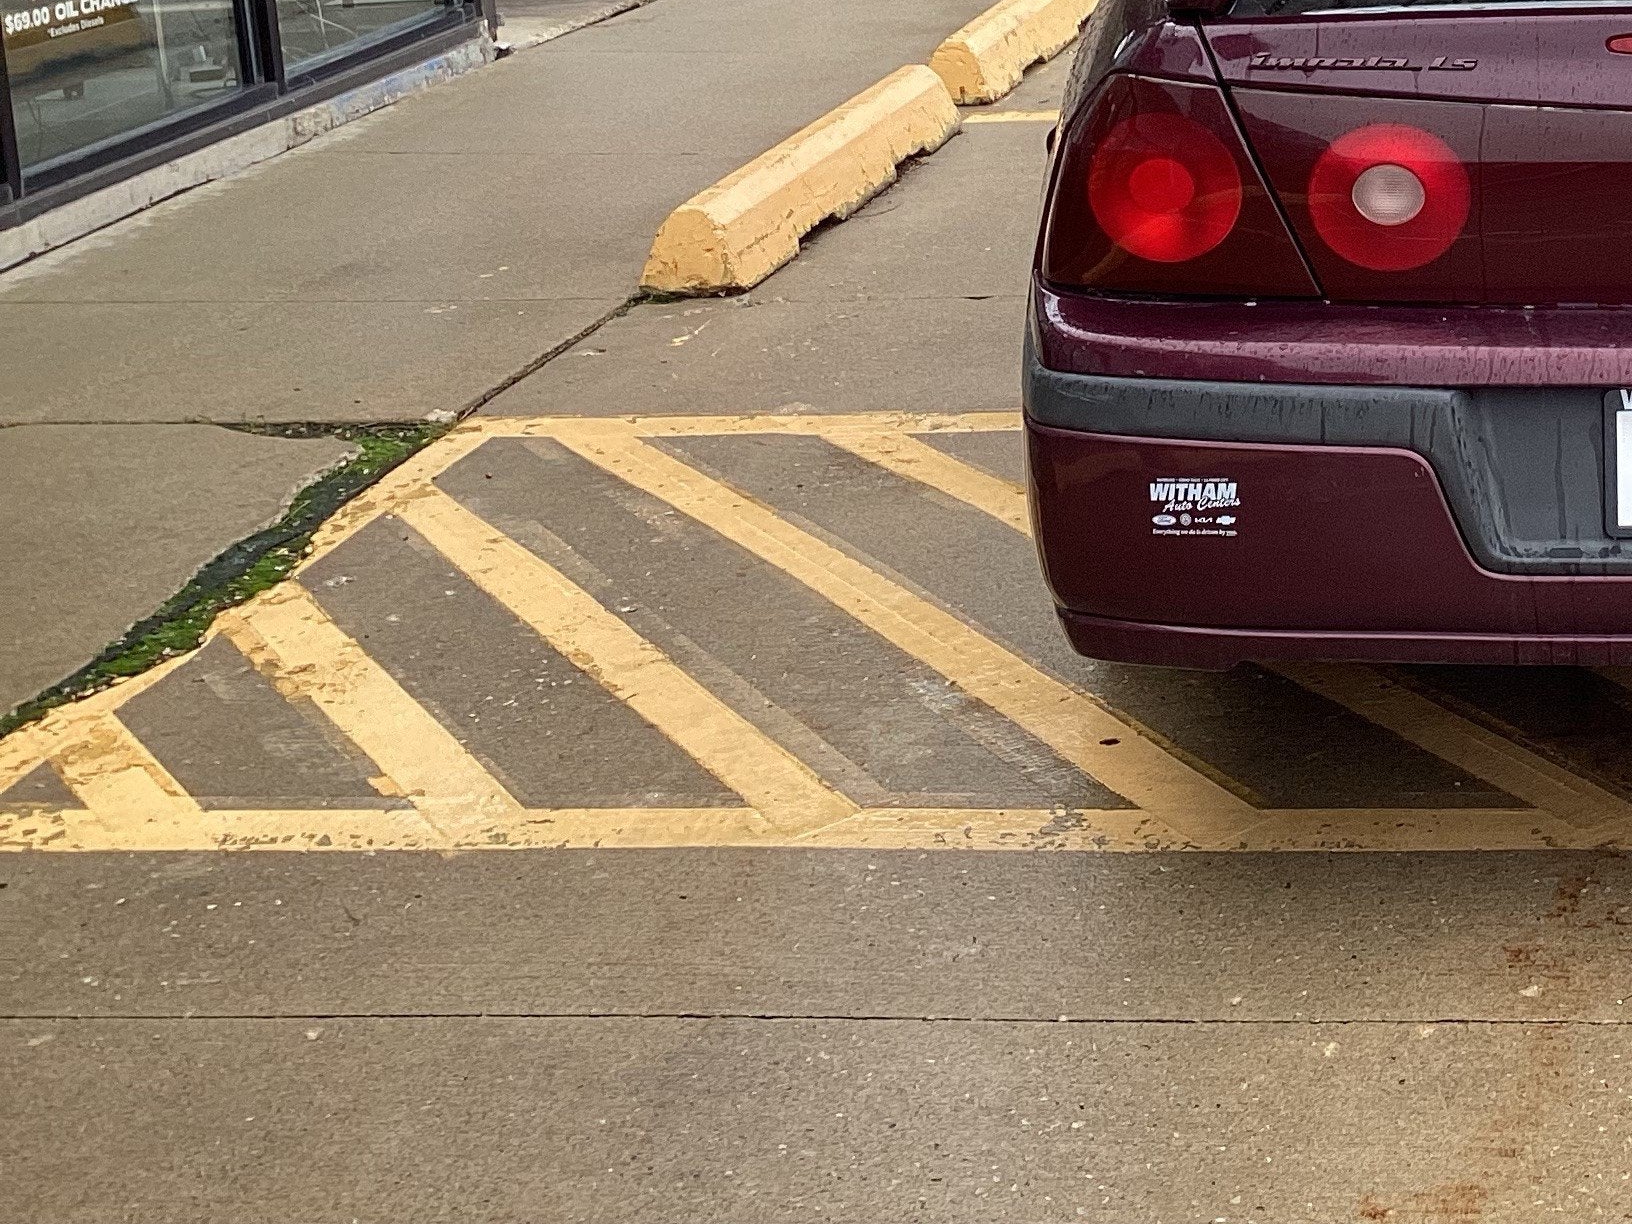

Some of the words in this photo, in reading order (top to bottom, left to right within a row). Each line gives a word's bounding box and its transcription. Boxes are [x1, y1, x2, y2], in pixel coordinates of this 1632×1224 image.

[4, 6, 50, 36] $69.00
[54, 0, 79, 21] OIL
[1149, 482, 1238, 501] WITHAM
[1162, 499, 1193, 512] Auto
